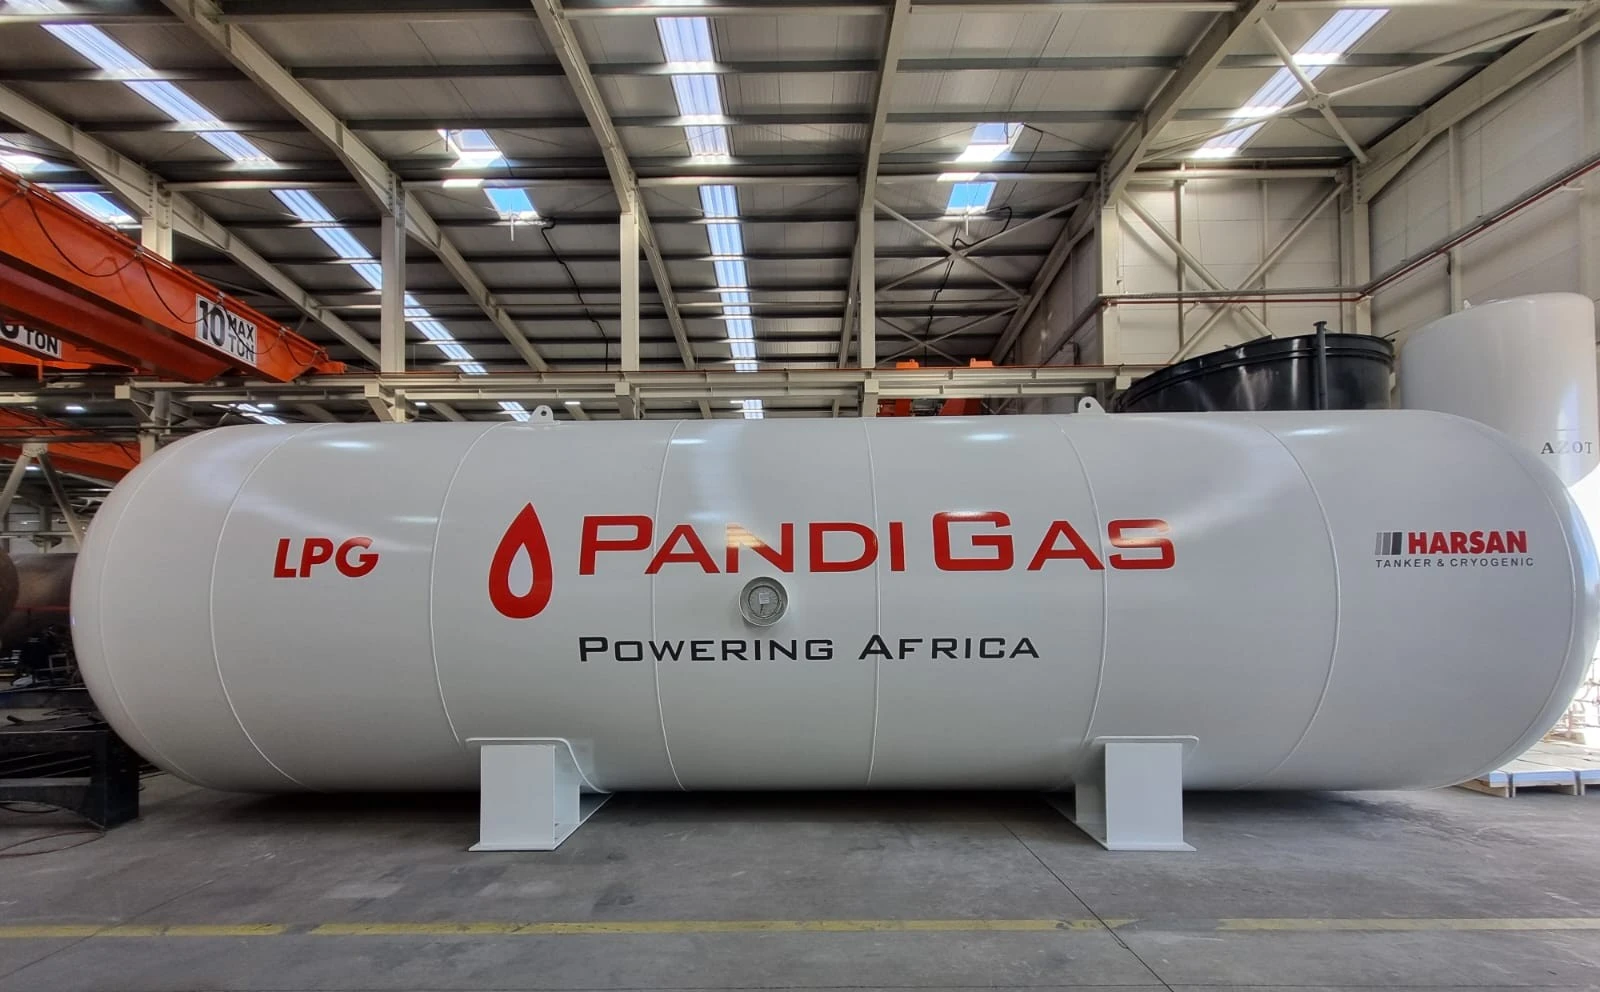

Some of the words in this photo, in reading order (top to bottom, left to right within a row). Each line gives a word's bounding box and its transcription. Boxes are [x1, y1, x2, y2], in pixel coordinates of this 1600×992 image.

[199, 300, 226, 347] 10
[227, 314, 254, 342] MAX
[25, 328, 58, 355] TON
[228, 332, 254, 362] TON
[1408, 531, 1528, 555] HARSAN
[273, 536, 379, 579] LPG
[1376, 559, 1432, 569] TANKER
[1437, 558, 1445, 568] &
[1450, 557, 1535, 568] CRYOGENIC
[578, 636, 834, 662] POWERING
[858, 634, 1040, 661] AFRICA
